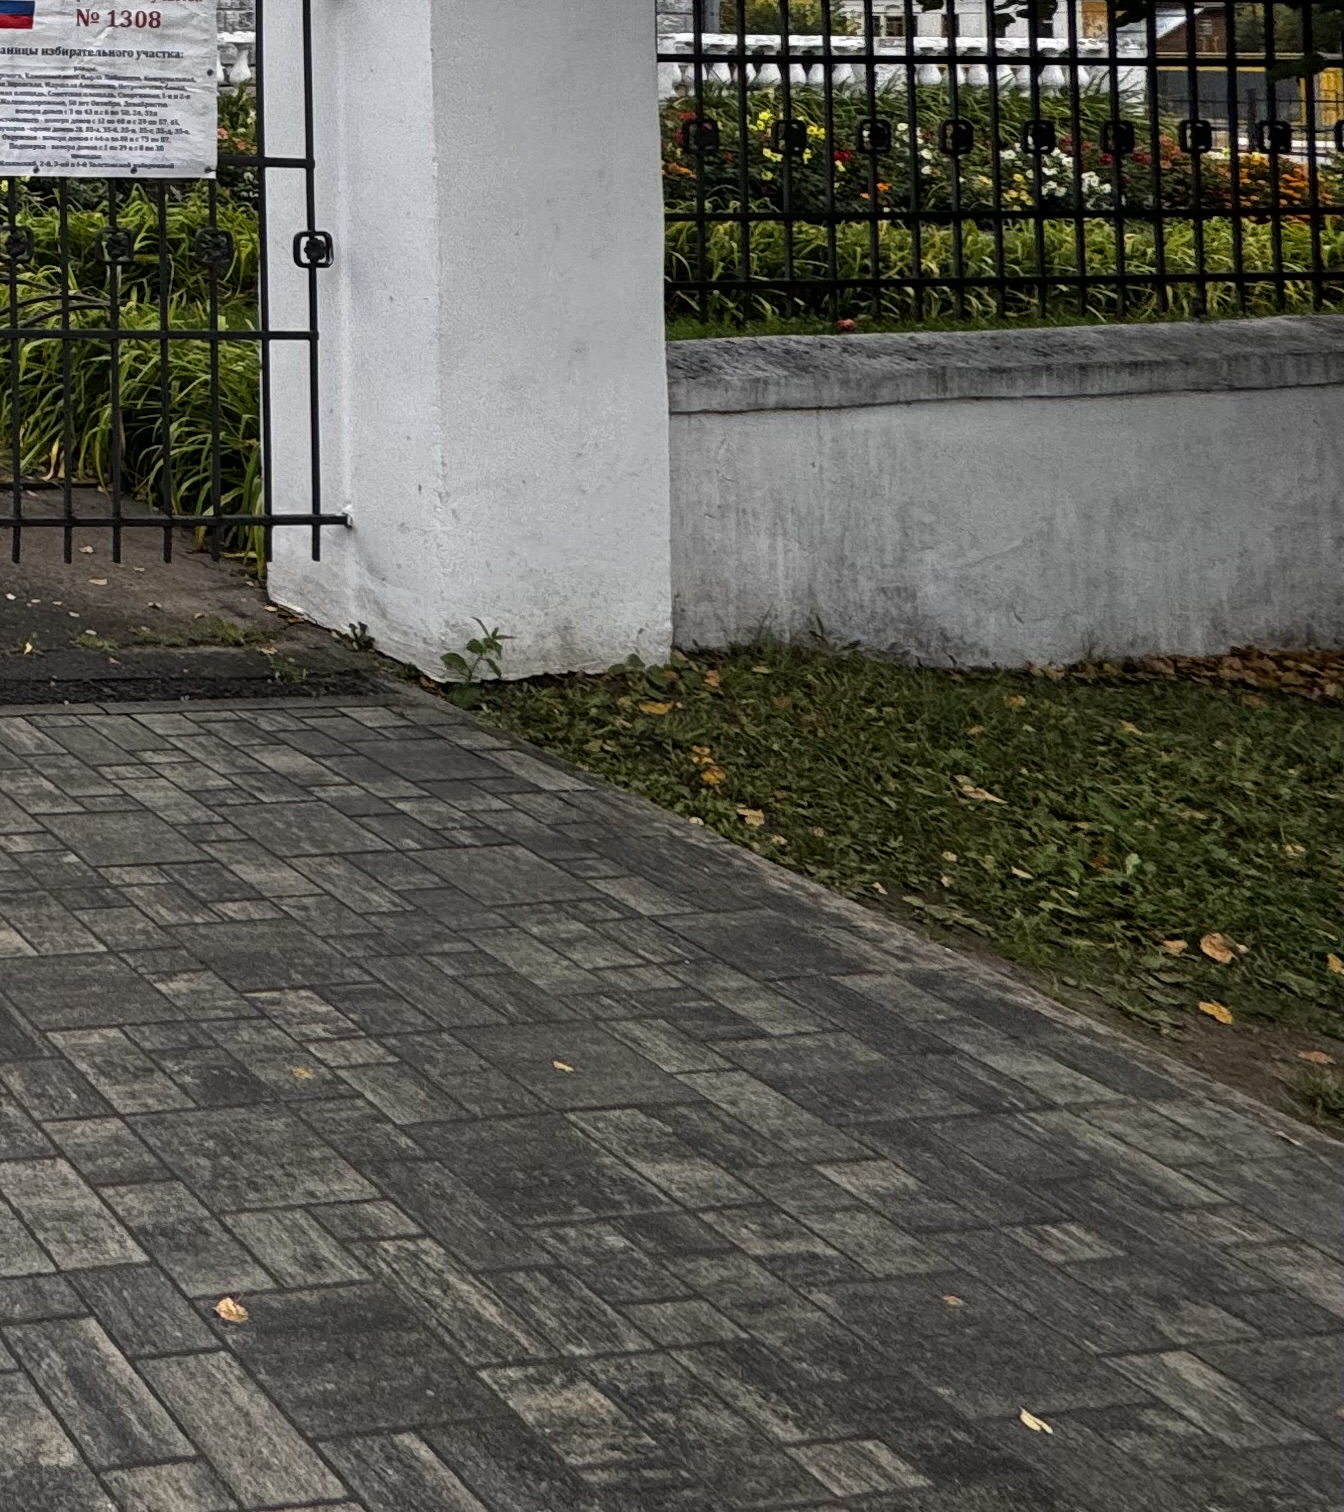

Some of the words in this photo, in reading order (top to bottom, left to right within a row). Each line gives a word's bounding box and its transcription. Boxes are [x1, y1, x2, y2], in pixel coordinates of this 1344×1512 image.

[75, 8, 100, 27] №
[107, 9, 162, 28] 1308
[41, 46, 134, 58] избирательного
[136, 48, 184, 59] участка:
